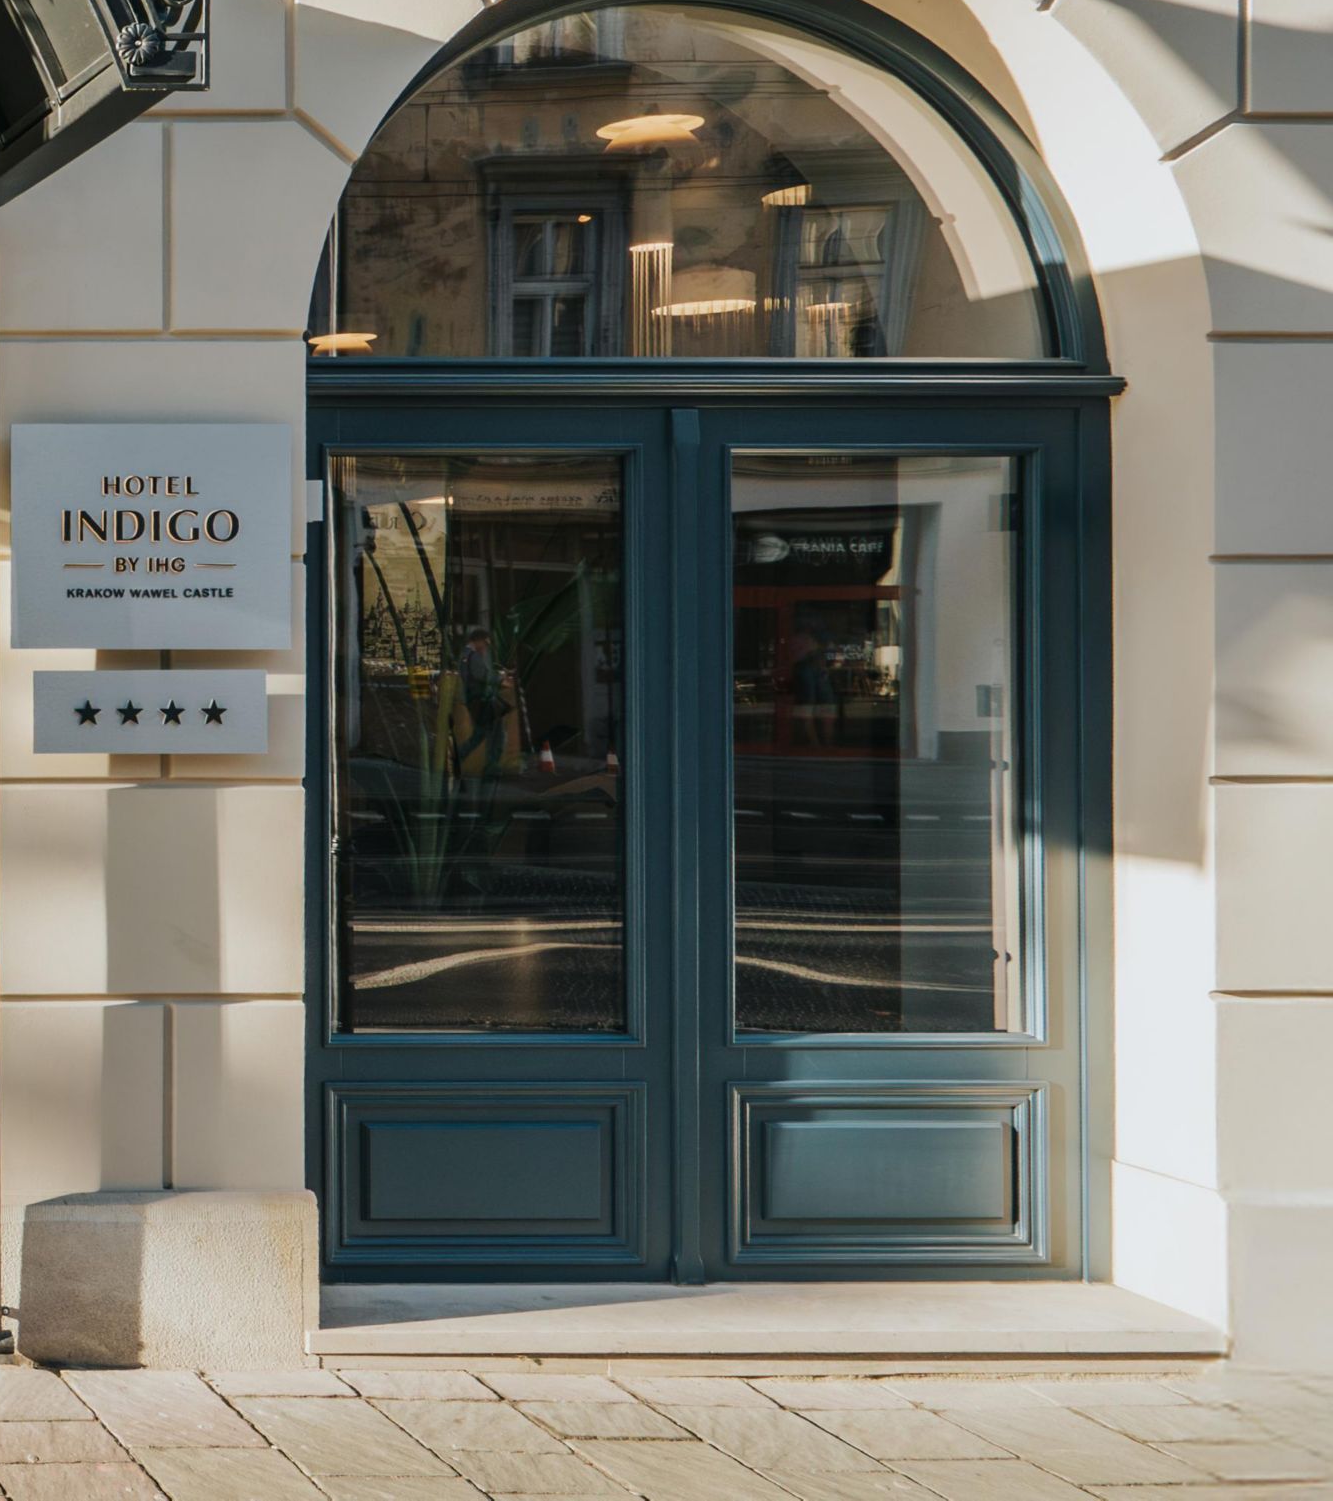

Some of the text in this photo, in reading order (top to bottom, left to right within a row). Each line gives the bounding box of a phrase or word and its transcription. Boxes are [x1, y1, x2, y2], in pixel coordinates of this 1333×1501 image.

[100, 475, 200, 497] HOTEL
[60, 508, 241, 544] INDIGO
[113, 557, 187, 574] BY IHG
[66, 587, 234, 599] KRAKOW WAWEL CASTLE
